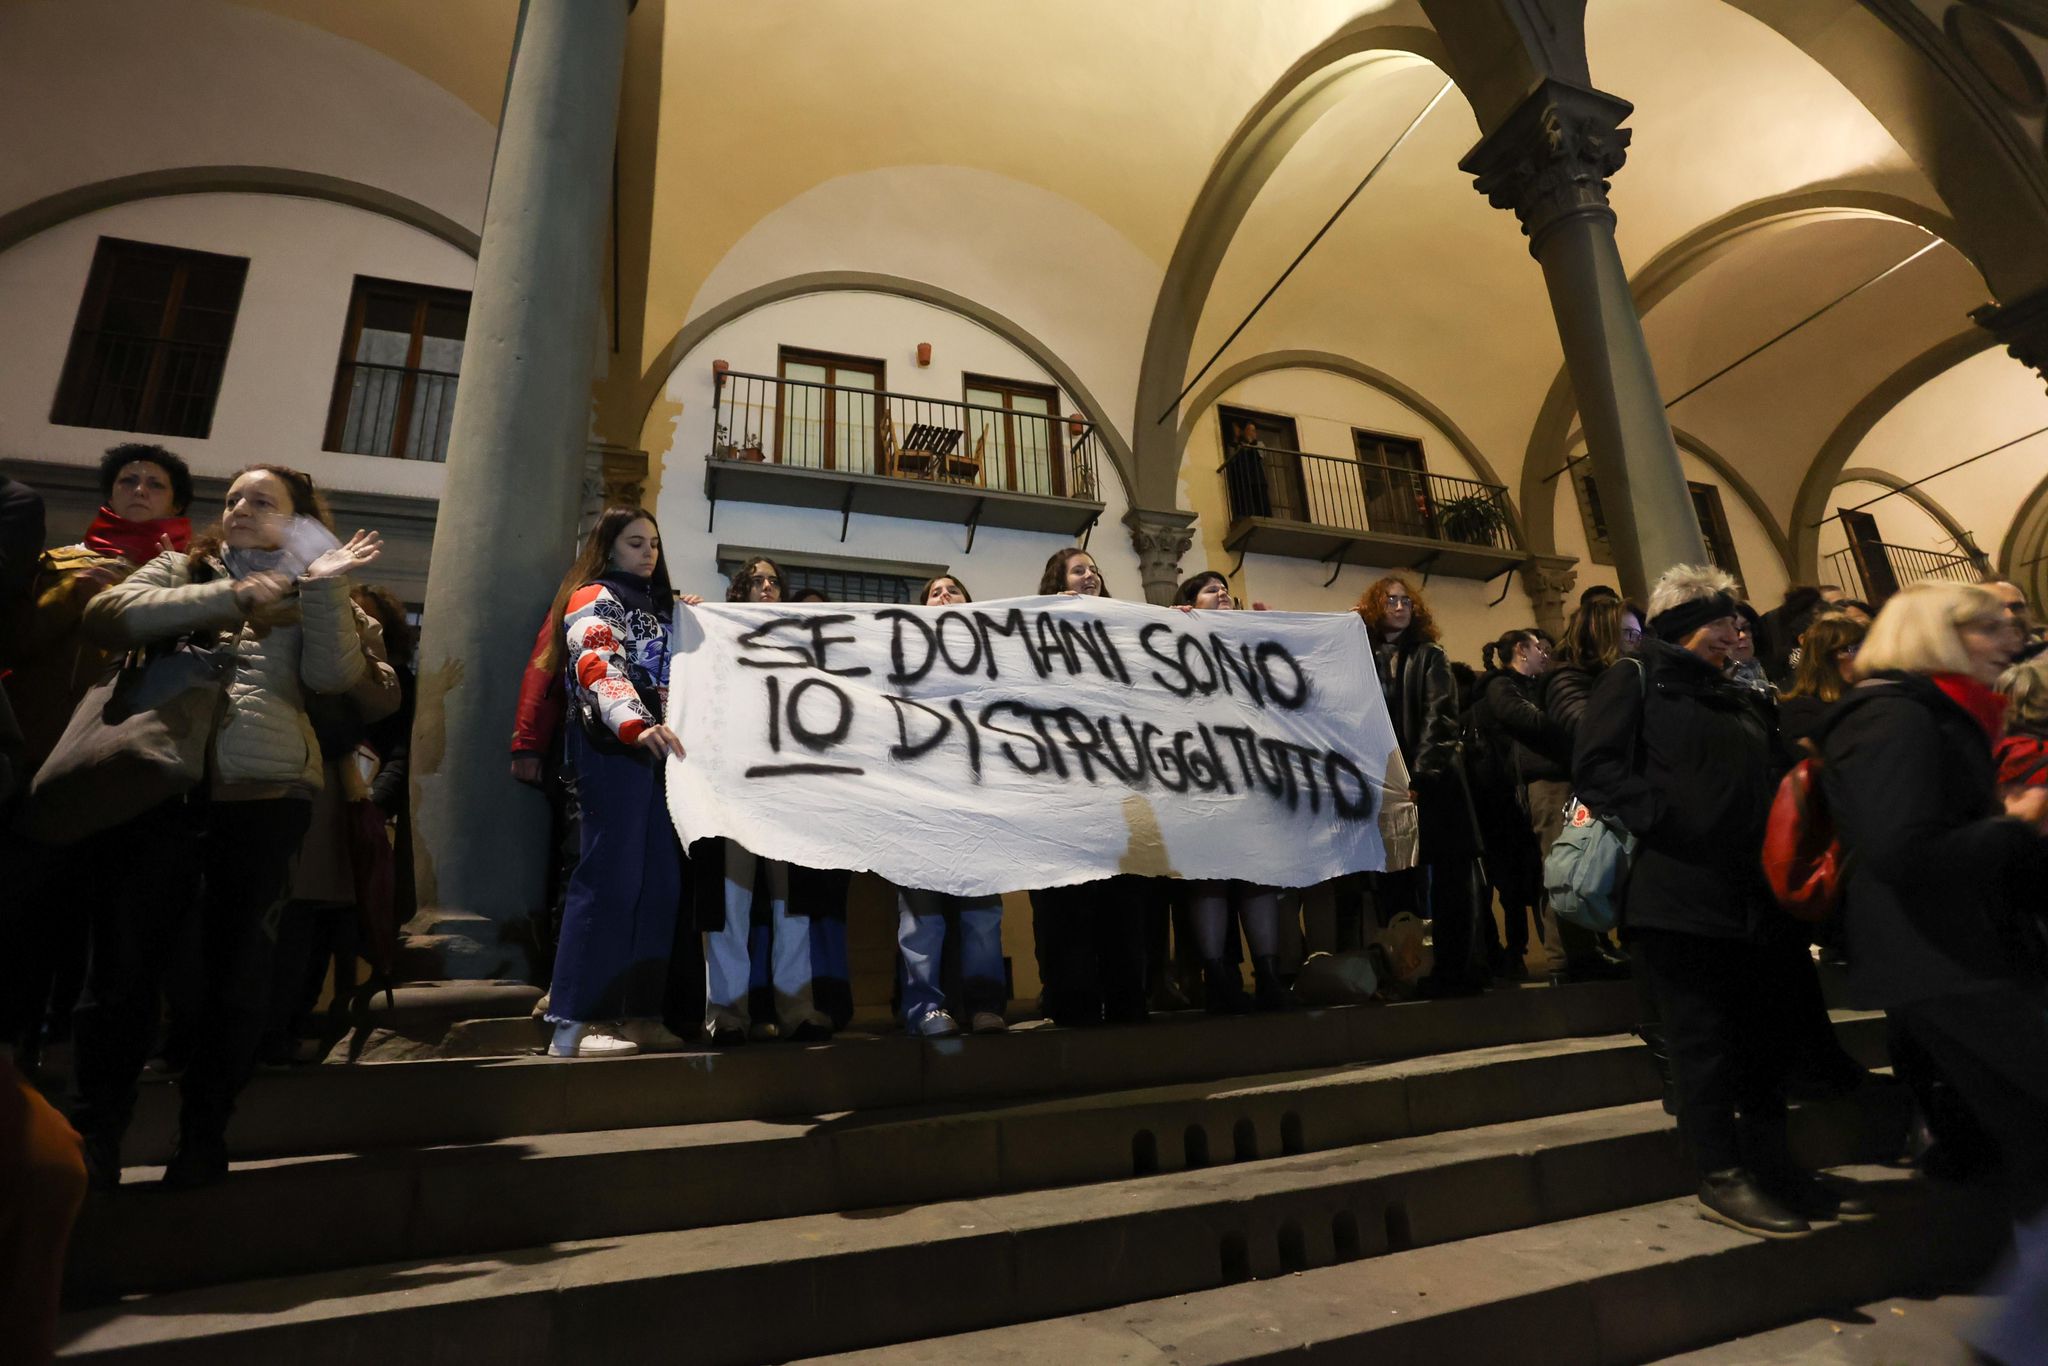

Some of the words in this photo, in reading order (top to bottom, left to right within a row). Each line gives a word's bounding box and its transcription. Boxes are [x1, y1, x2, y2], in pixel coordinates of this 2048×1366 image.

[737, 614, 871, 677] SE
[875, 608, 1131, 685] DOMANI
[1139, 622, 1308, 710] SONO
